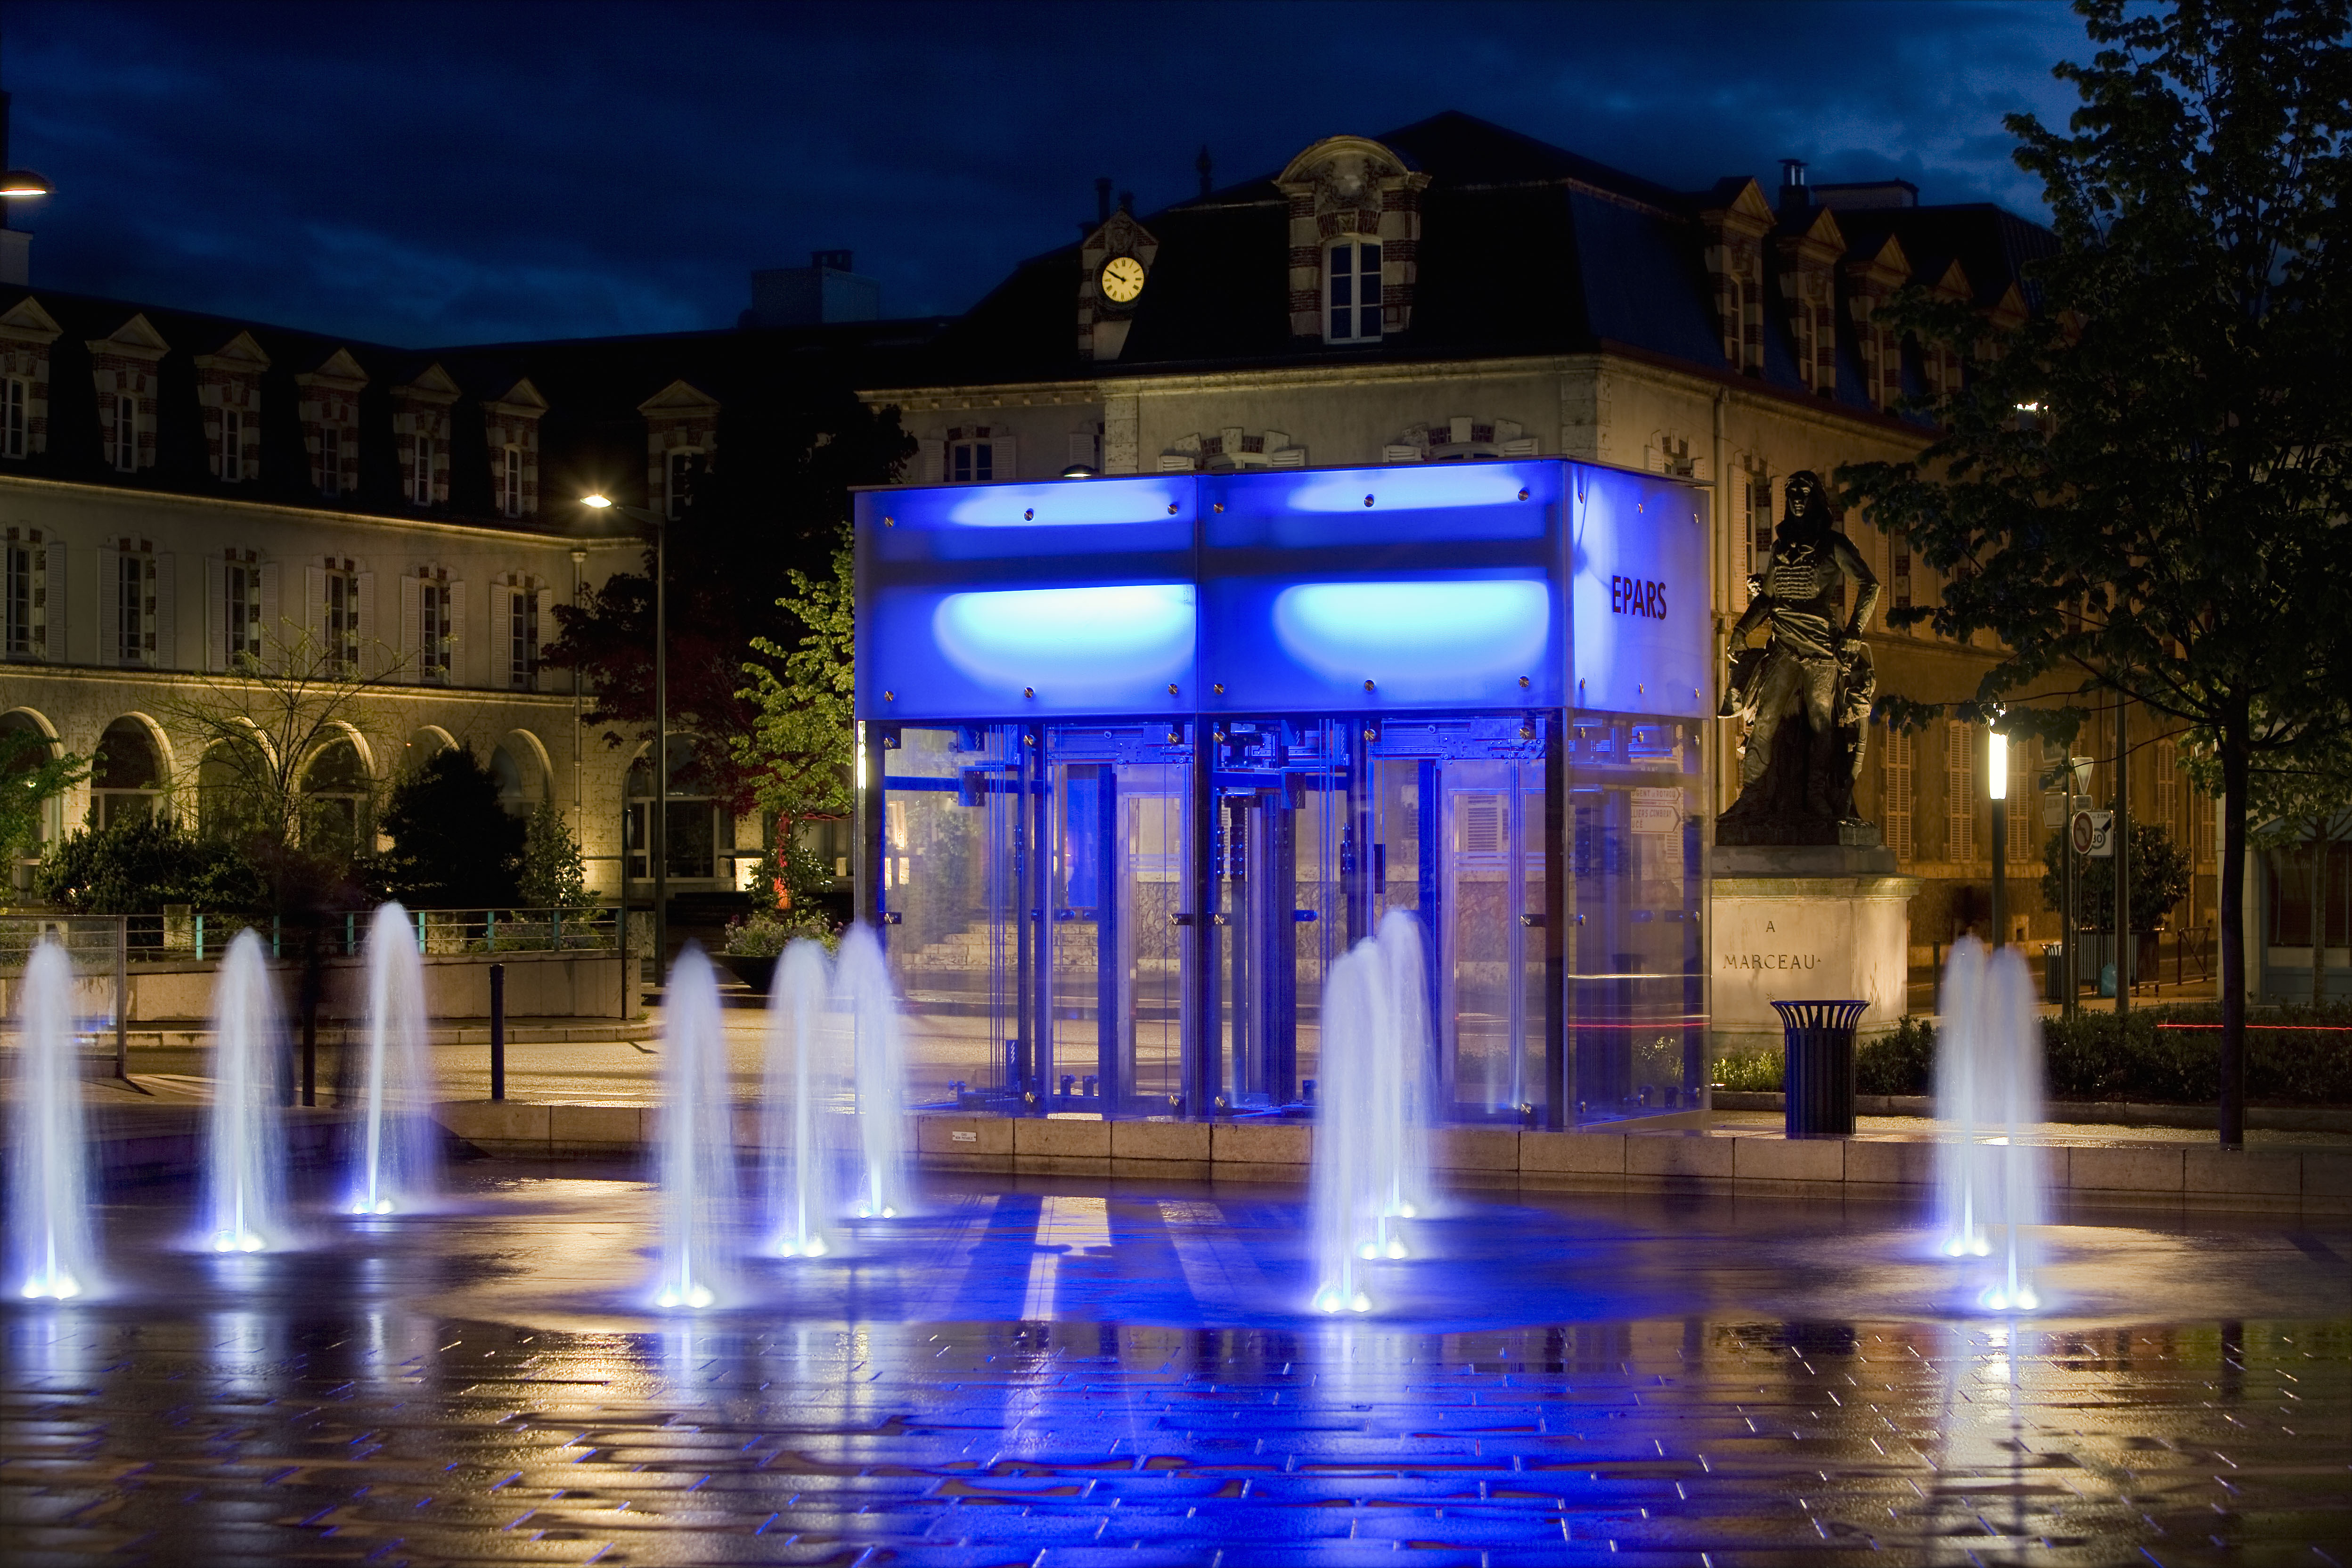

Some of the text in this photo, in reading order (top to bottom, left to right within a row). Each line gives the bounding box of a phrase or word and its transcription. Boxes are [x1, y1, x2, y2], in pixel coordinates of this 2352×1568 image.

[1612, 575, 1667, 620] EPARS
[1650, 809, 1672, 818] COMBRAY
[1632, 818, 1643, 828] UCÉ
[1765, 920, 1775, 932] A
[1723, 954, 1815, 969] MARCEAU
